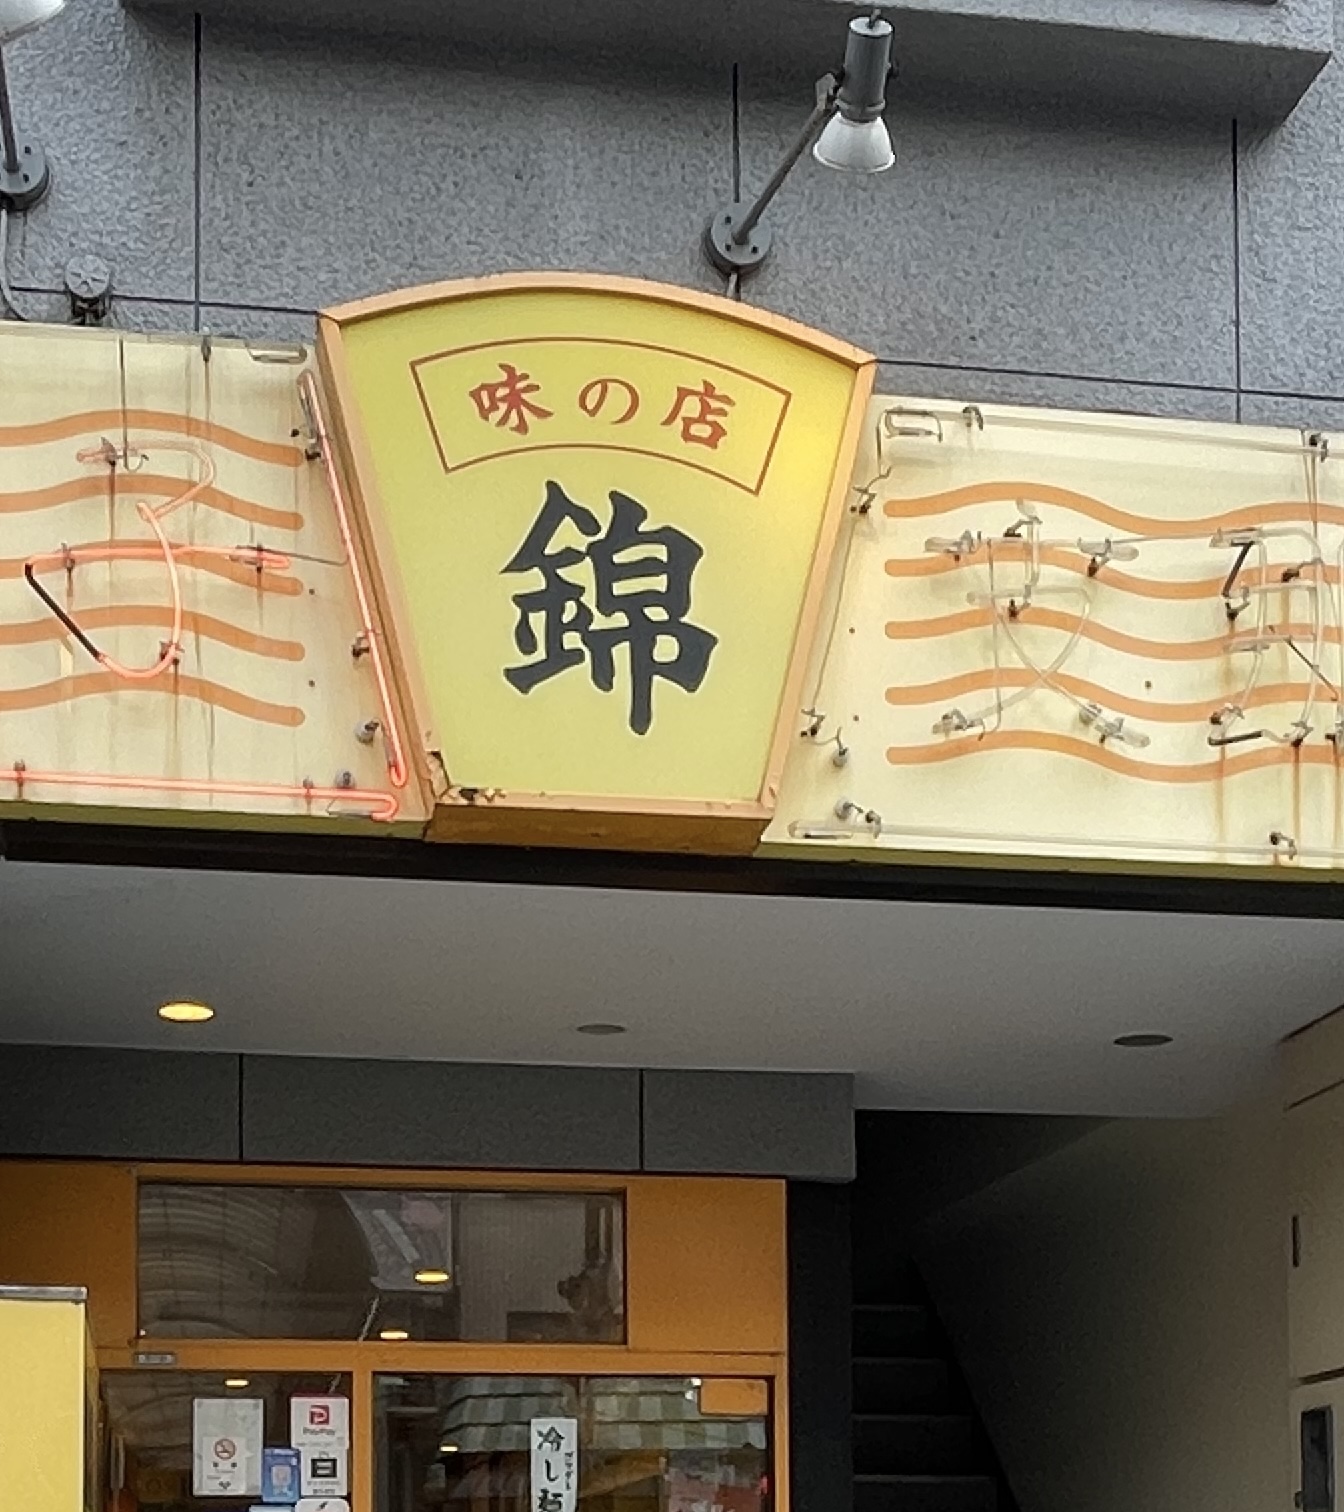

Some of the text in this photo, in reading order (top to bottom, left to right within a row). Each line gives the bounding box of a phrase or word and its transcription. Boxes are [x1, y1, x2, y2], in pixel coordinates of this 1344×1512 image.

[468, 362, 732, 453] 味の店
[500, 478, 720, 738] 錦
